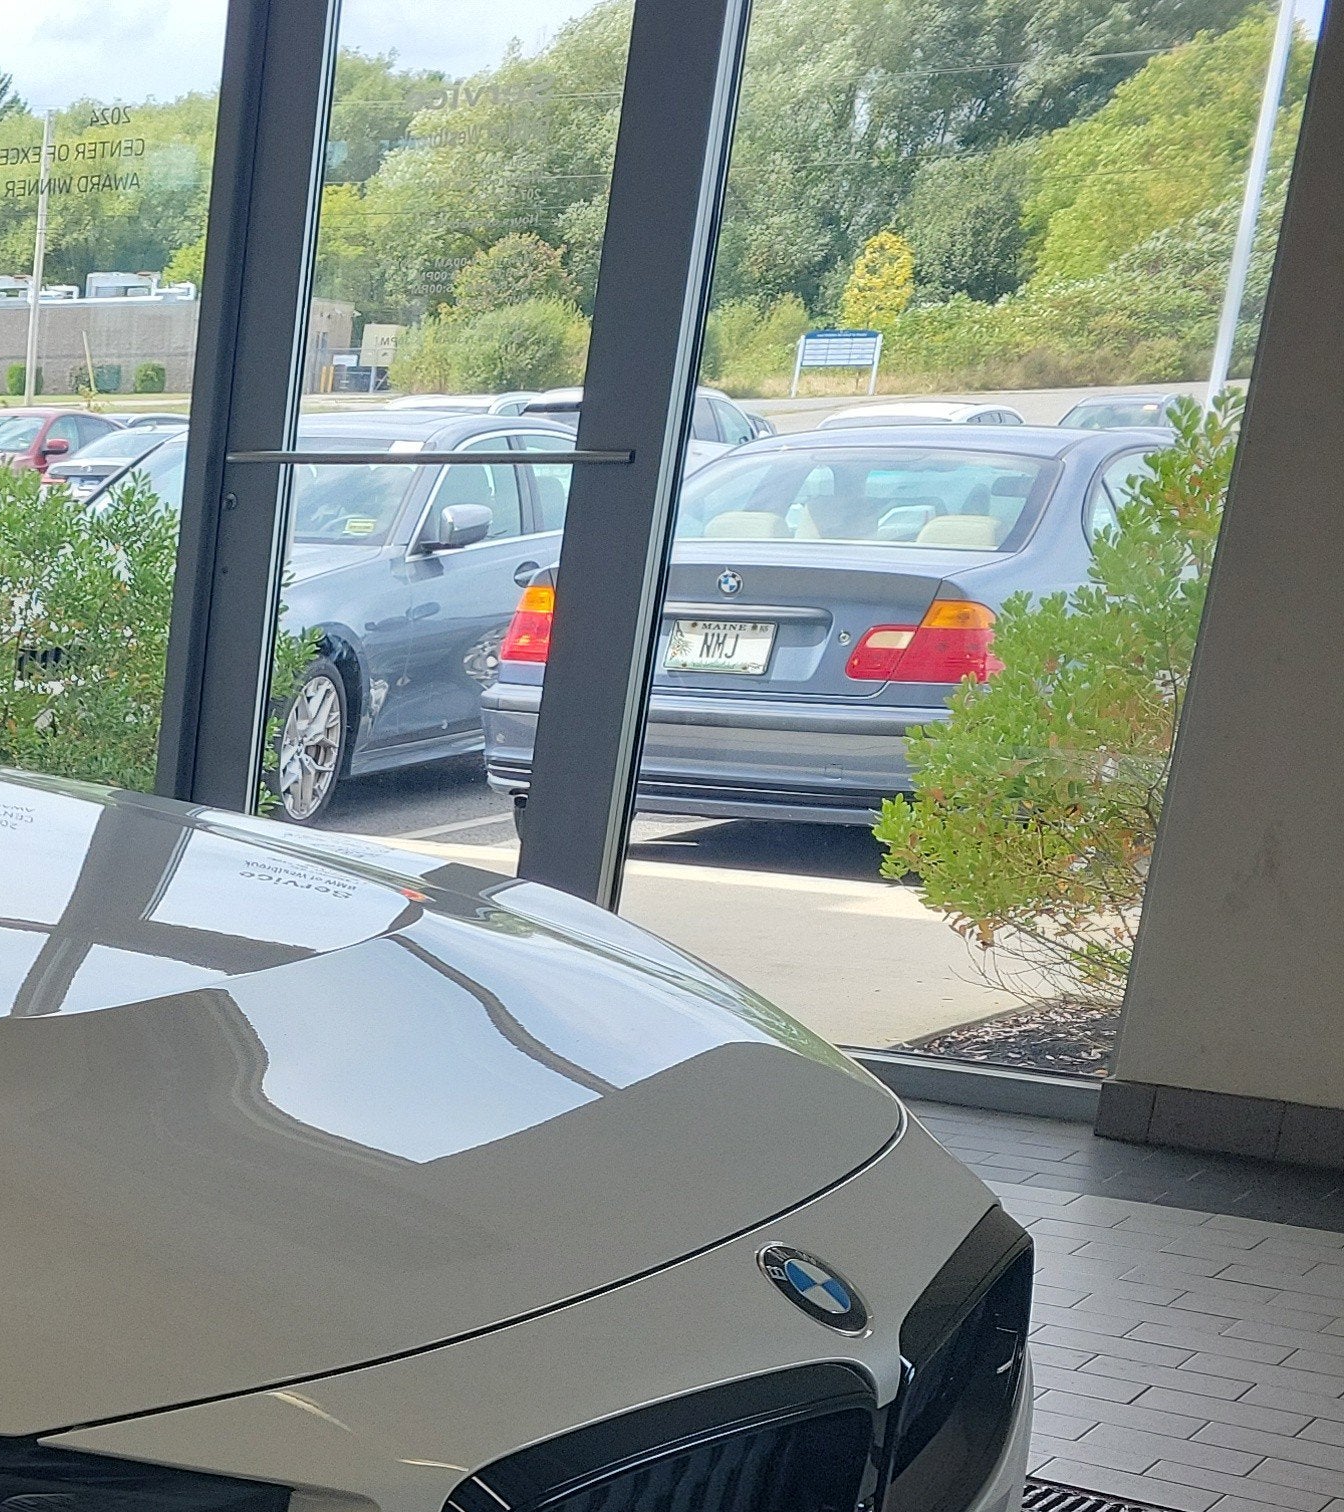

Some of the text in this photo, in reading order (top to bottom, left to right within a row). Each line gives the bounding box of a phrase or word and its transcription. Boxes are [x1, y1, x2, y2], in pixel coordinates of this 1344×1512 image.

[701, 622, 747, 631] MAINE
[699, 632, 740, 659] NMJ
[238, 870, 353, 900] Service
